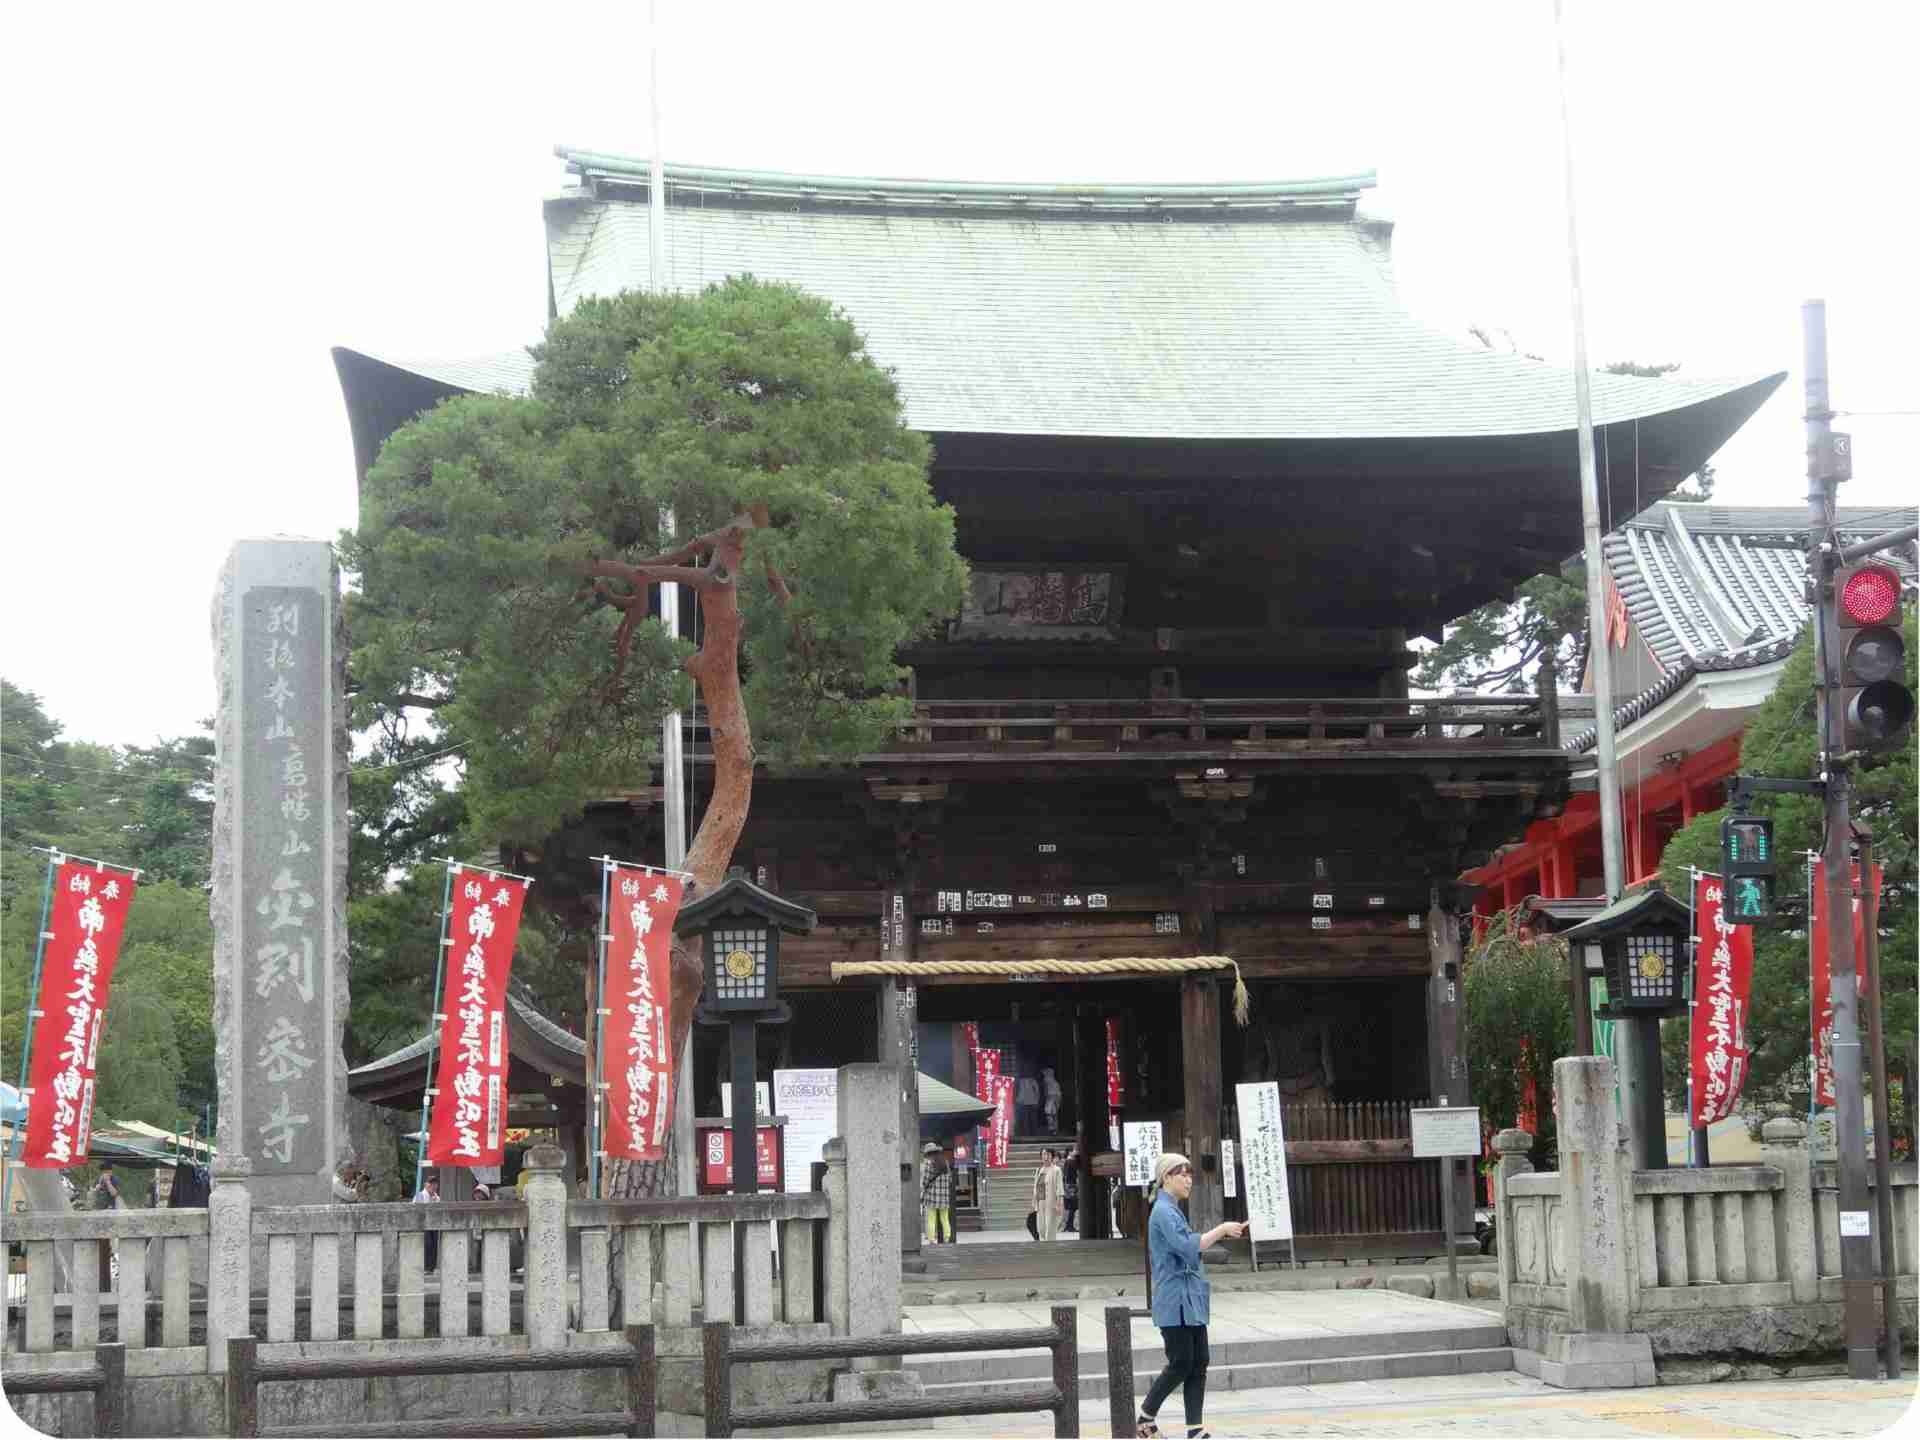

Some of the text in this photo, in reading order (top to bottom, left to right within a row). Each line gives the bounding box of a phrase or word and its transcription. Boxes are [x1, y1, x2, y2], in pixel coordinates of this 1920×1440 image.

[45, 897, 105, 1163] 南無大聖不動明王
[452, 903, 495, 1158] 南無大聖不動明王
[624, 900, 655, 1152] 南無大聖不動明王
